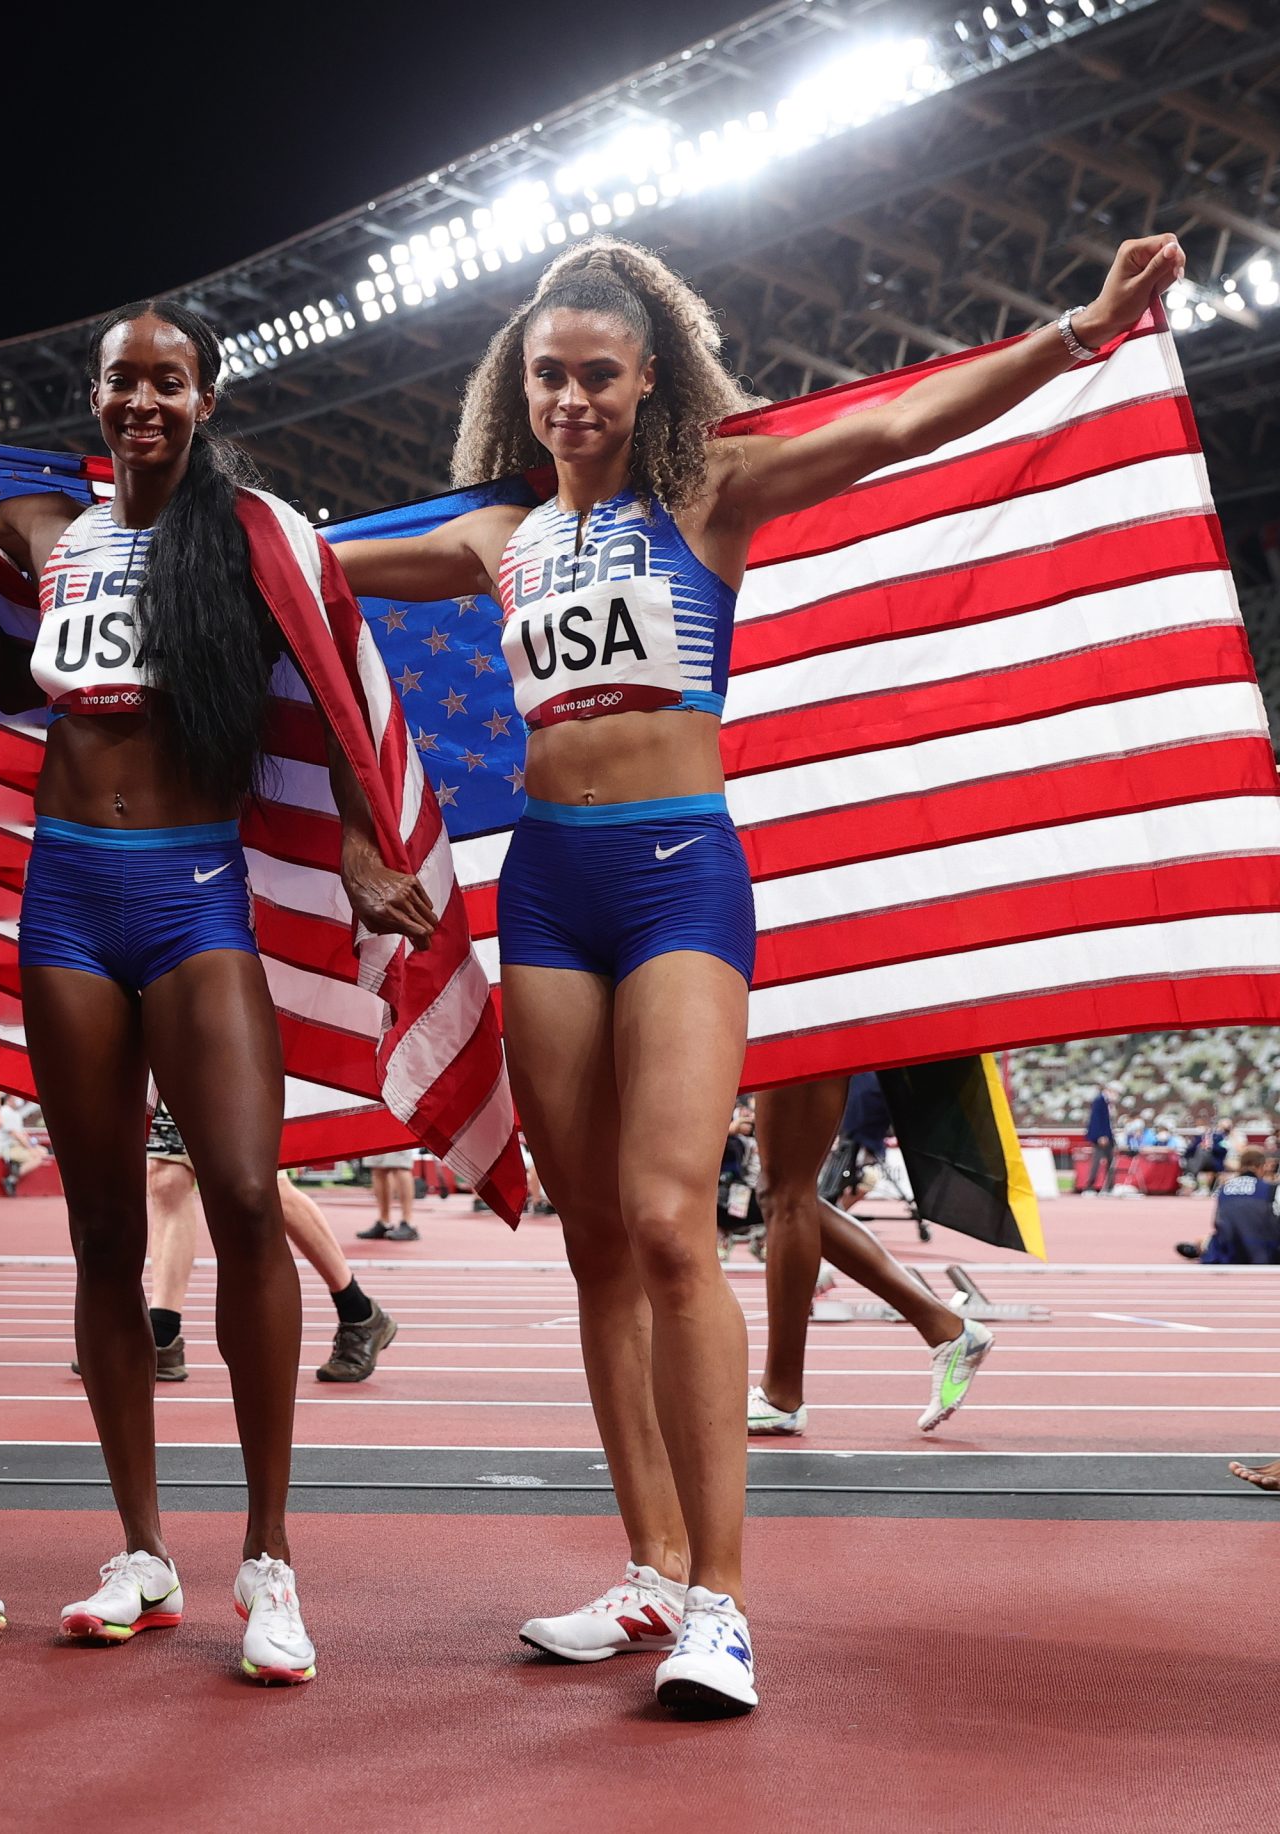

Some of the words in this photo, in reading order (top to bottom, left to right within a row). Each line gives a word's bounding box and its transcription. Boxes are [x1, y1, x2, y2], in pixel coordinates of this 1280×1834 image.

[54, 569, 150, 609] US
[514, 530, 650, 609] USA
[521, 597, 647, 681] USA
[99, 695, 119, 704] 2020
[552, 701, 575, 715] TOKYO
[576, 698, 596, 710] 2020
